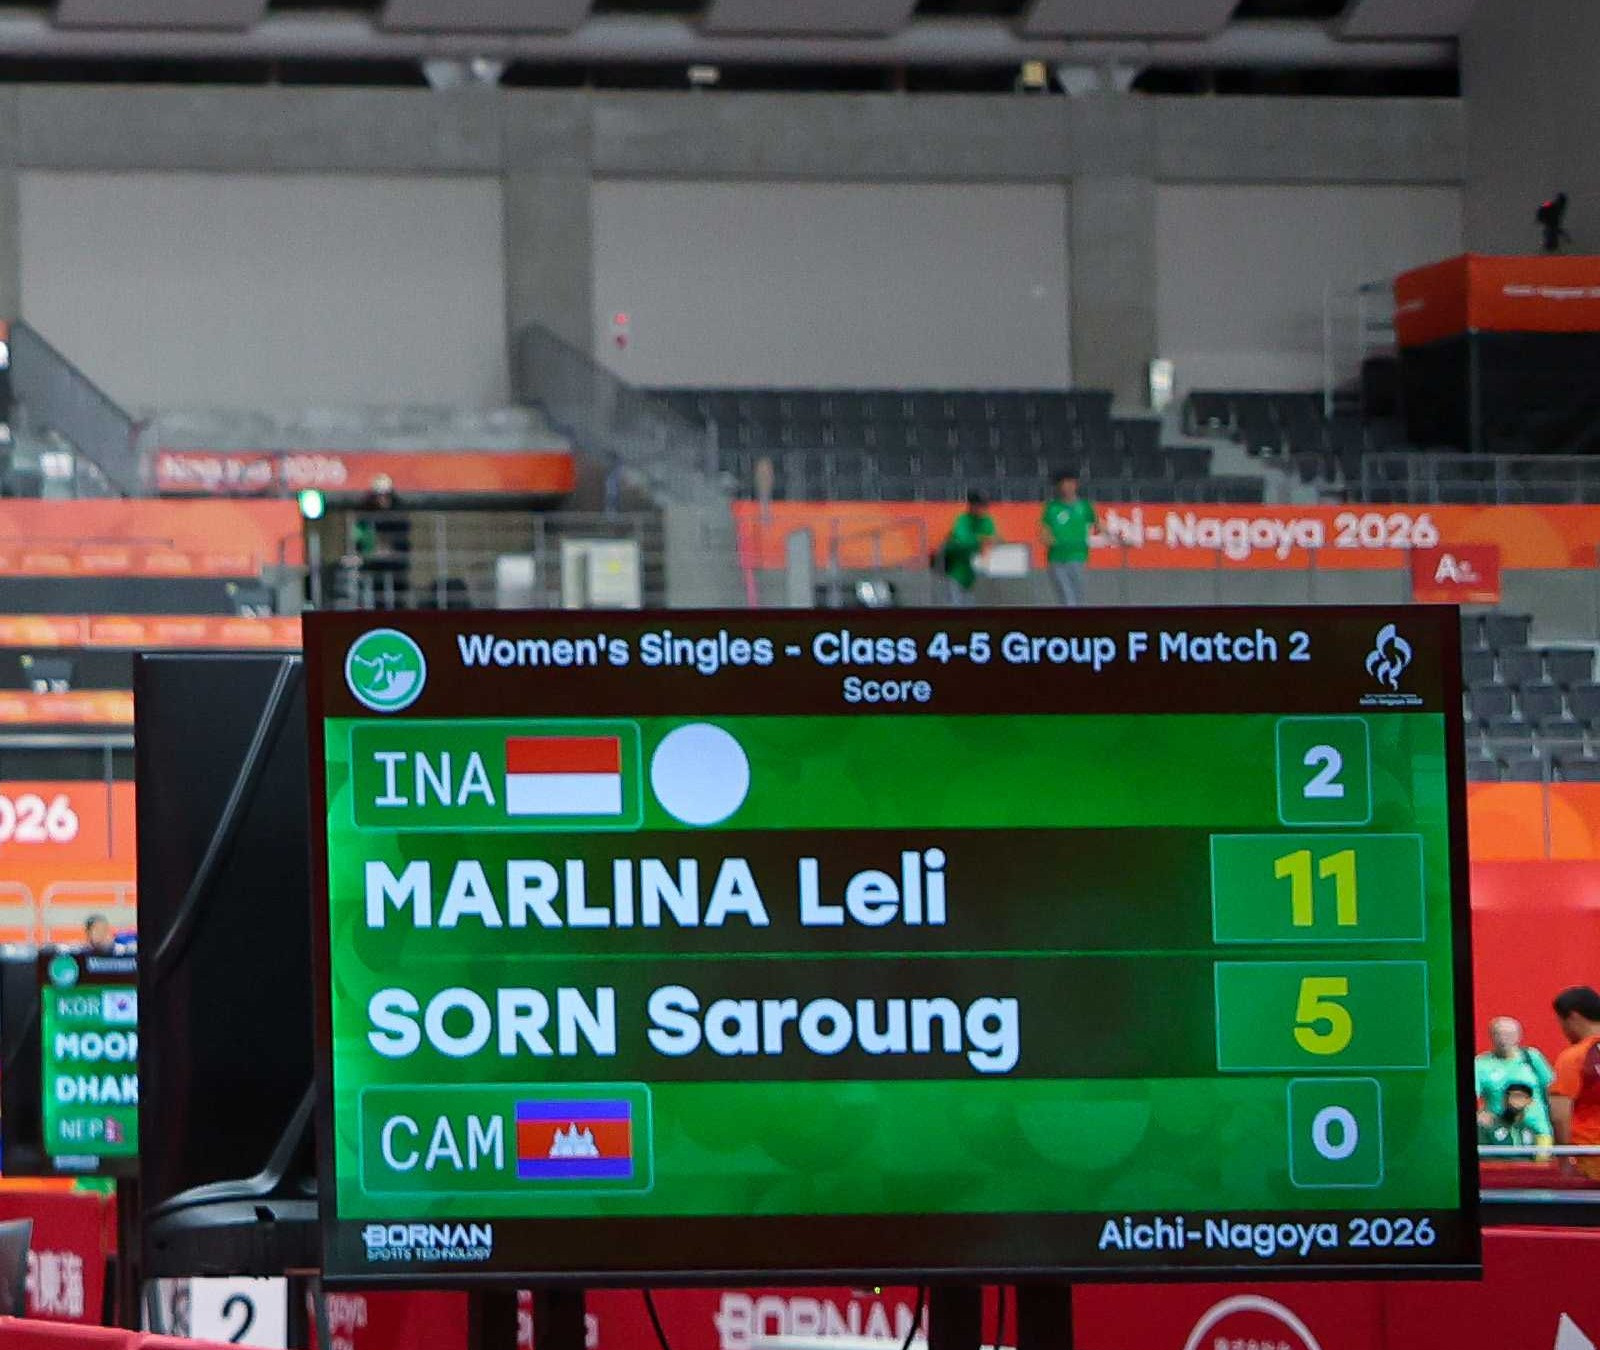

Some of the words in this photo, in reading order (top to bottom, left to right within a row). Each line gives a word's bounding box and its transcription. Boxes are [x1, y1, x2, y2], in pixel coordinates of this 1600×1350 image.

[1334, 512, 1439, 548] 2026
[456, 633, 631, 668] Women's
[639, 630, 775, 675] Singles
[812, 629, 918, 665] Class
[926, 632, 991, 664] 4-5
[1001, 632, 1117, 672] Group
[1127, 631, 1150, 663] F
[1159, 631, 1278, 664] Match
[1288, 631, 1311, 663] 2
[842, 677, 932, 703] Score
[373, 749, 496, 807] INA
[1302, 744, 1345, 798] 2
[364, 857, 770, 928] MARLINA
[798, 846, 947, 927] Leli
[1273, 849, 1358, 927] 11
[57, 997, 101, 1017] KOR
[366, 985, 618, 1059] SORN
[646, 983, 1021, 1074] Saroung
[1293, 976, 1353, 1056] 5
[379, 1114, 505, 1171] CAM
[1311, 1105, 1359, 1160] 0
[361, 1222, 493, 1249] BORNAN
[1098, 1217, 1339, 1258] Aichi-Nagoya
[1347, 1217, 1436, 1247] 2026
[220, 1293, 256, 1344] 2
